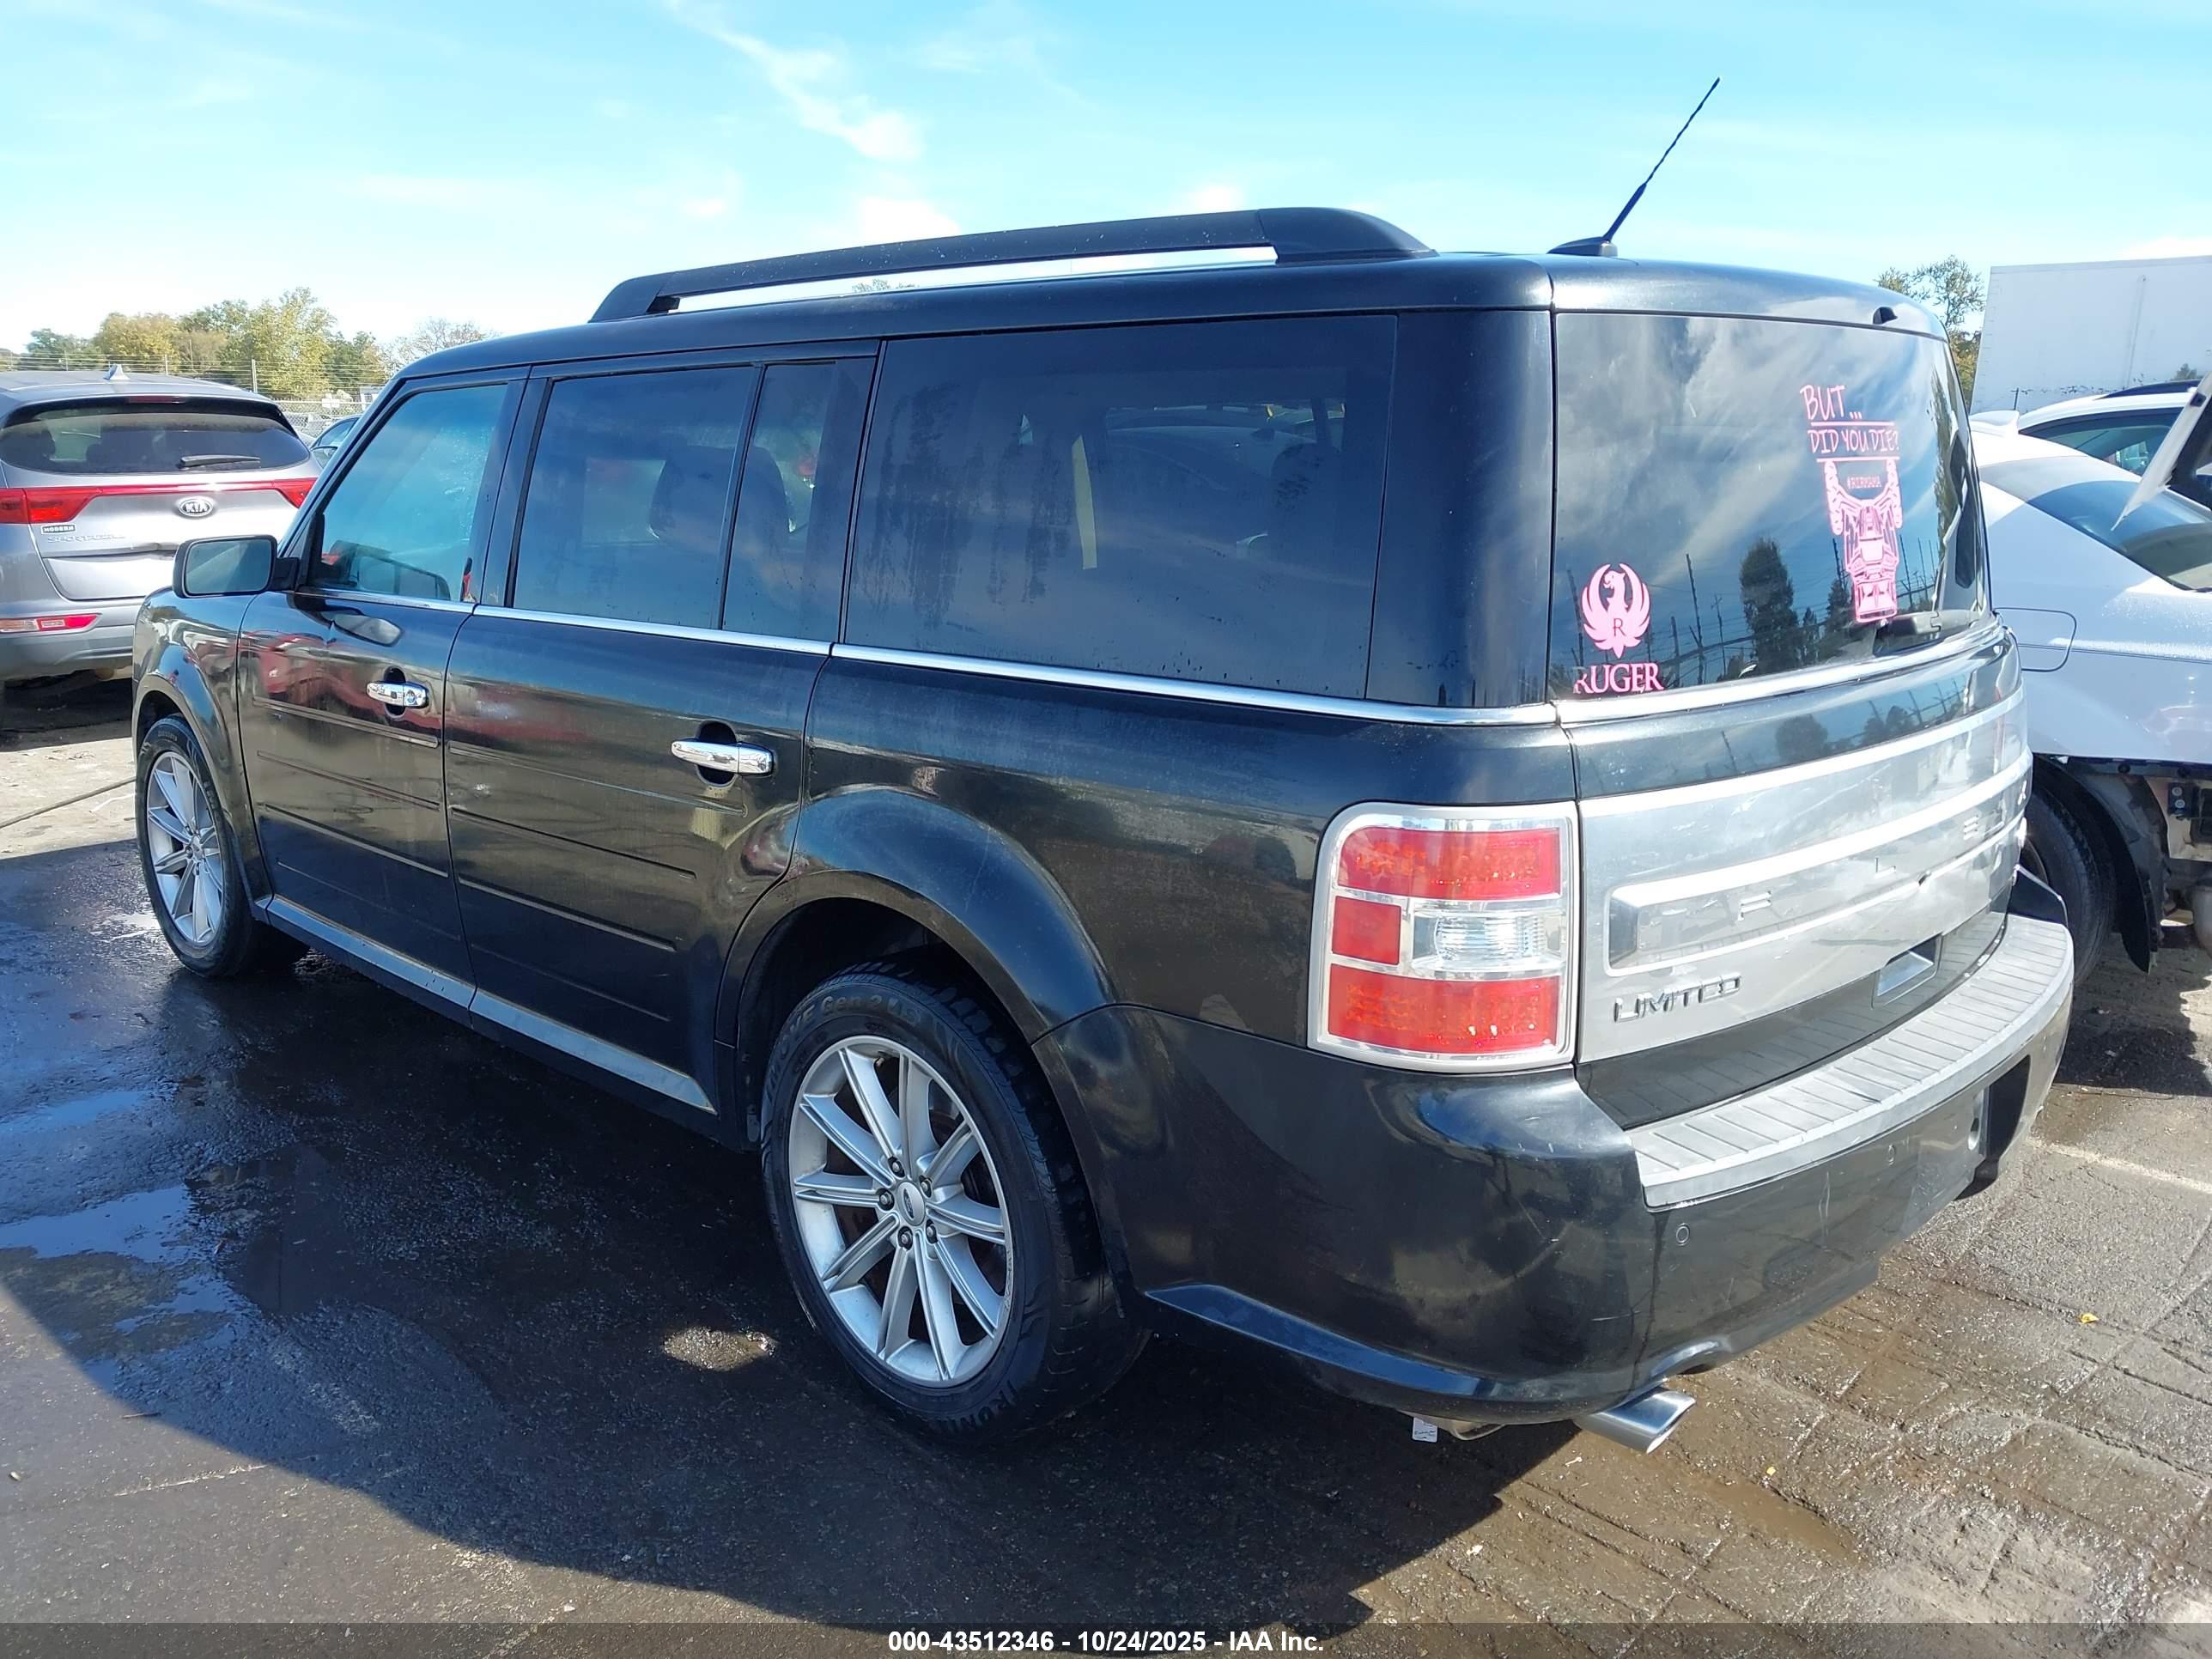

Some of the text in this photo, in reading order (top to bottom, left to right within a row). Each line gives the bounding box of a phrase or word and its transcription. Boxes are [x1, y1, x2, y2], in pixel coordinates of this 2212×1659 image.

[1807, 428, 1900, 454] DID YOU DIE?
[1612, 617, 1627, 637] R
[1613, 972, 1743, 1023] LIMITED
